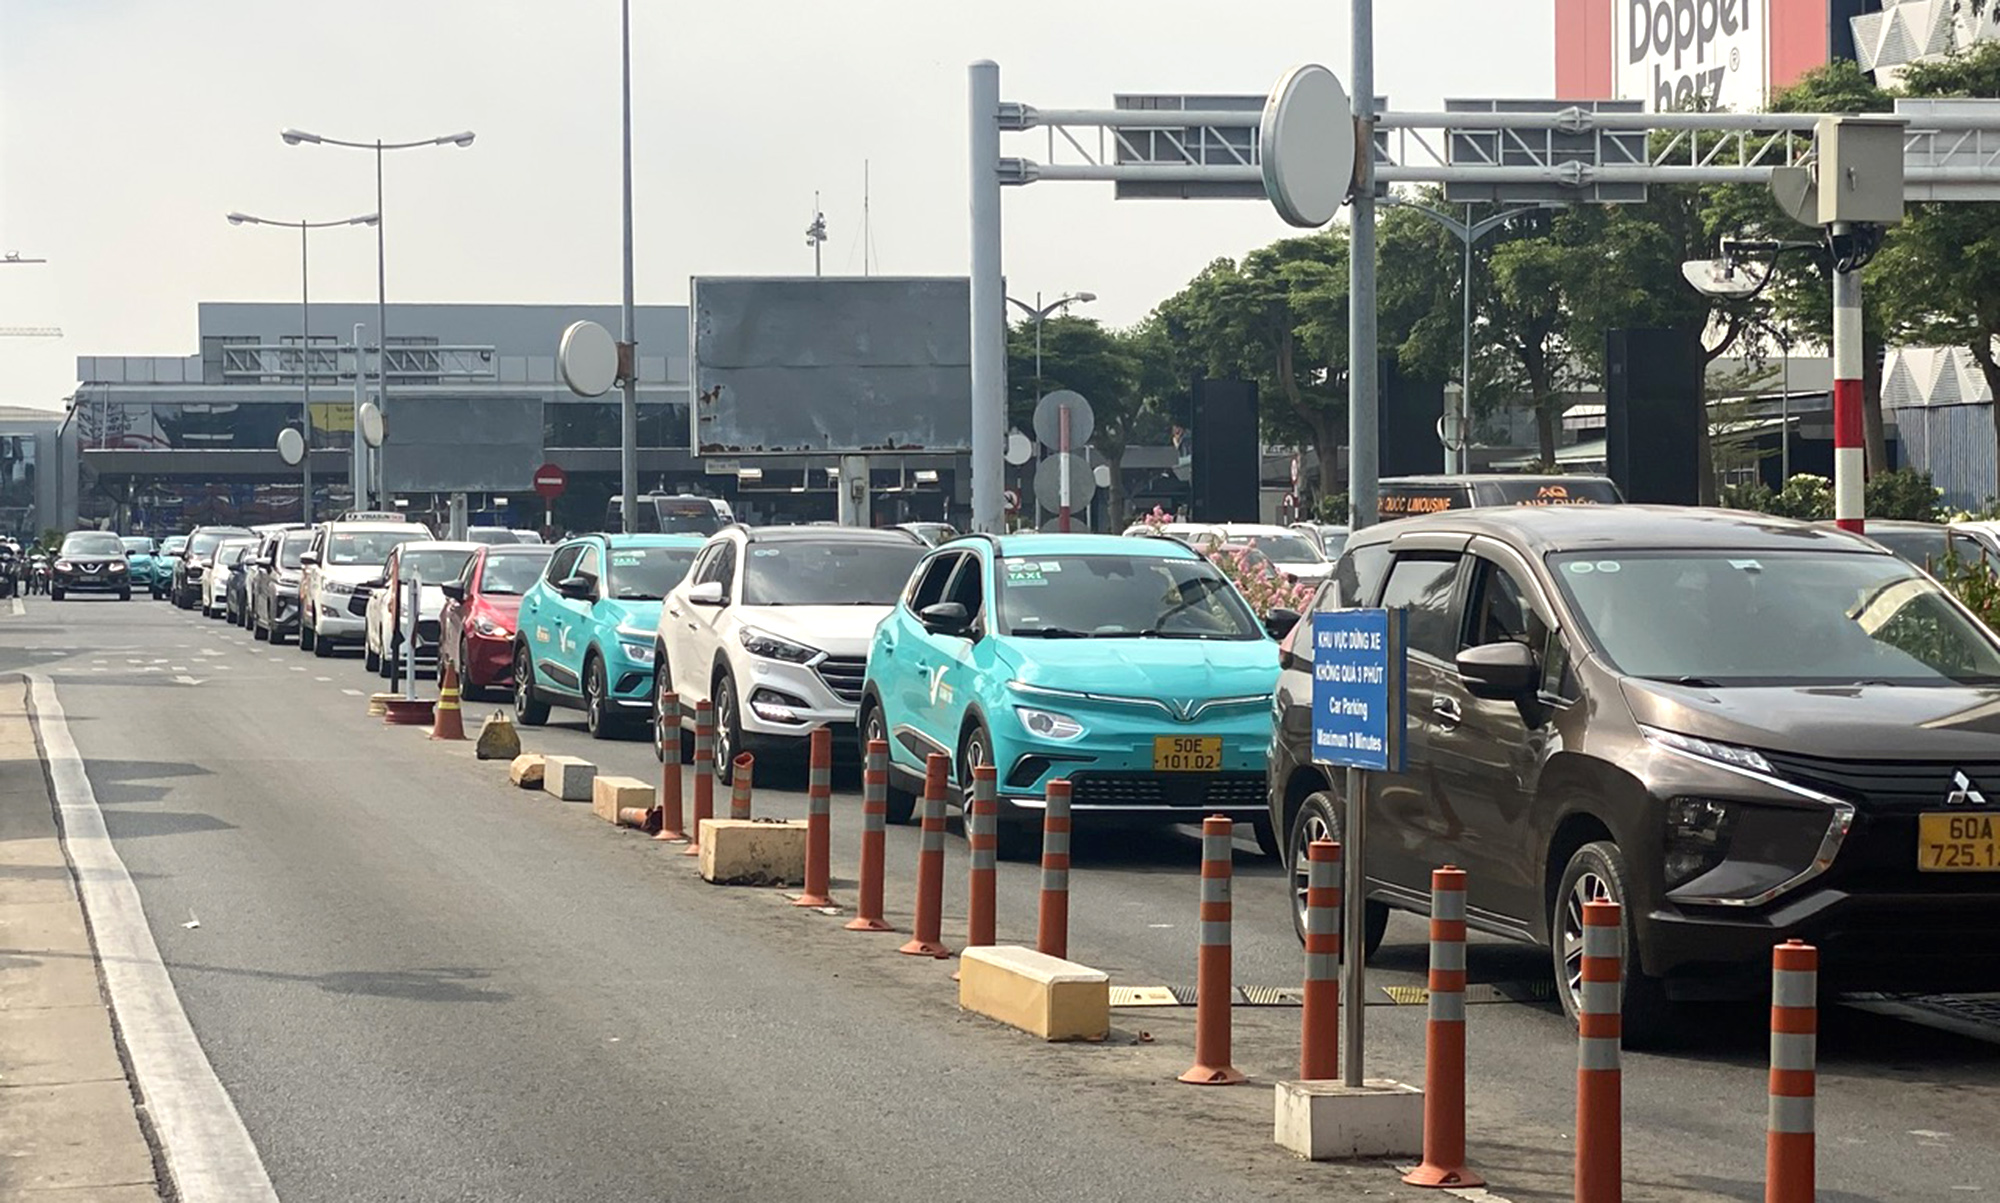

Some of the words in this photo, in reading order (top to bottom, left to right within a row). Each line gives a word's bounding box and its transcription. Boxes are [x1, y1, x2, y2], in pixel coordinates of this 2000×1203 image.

[1406, 496, 1451, 512] LIMOUSINE
[1008, 571, 1042, 580] TAXI
[1318, 631, 1332, 648] KHU
[1370, 632, 1381, 650] XE
[1316, 660, 1340, 682] KHÔNG
[1342, 661, 1356, 683] QUÁ
[1357, 667, 1362, 683] 3
[1363, 662, 1383, 684] PHÚT
[1329, 697, 1341, 714] Car
[1342, 699, 1368, 721] Parking
[1174, 738, 1203, 754] 50E
[1316, 729, 1347, 748] Maximum
[1349, 732, 1354, 749] 3
[1355, 732, 1381, 752] Minutes
[1163, 754, 1214, 769] 101.02
[1951, 818, 1992, 839] 60A
[1931, 844, 2000, 866] 725.1
